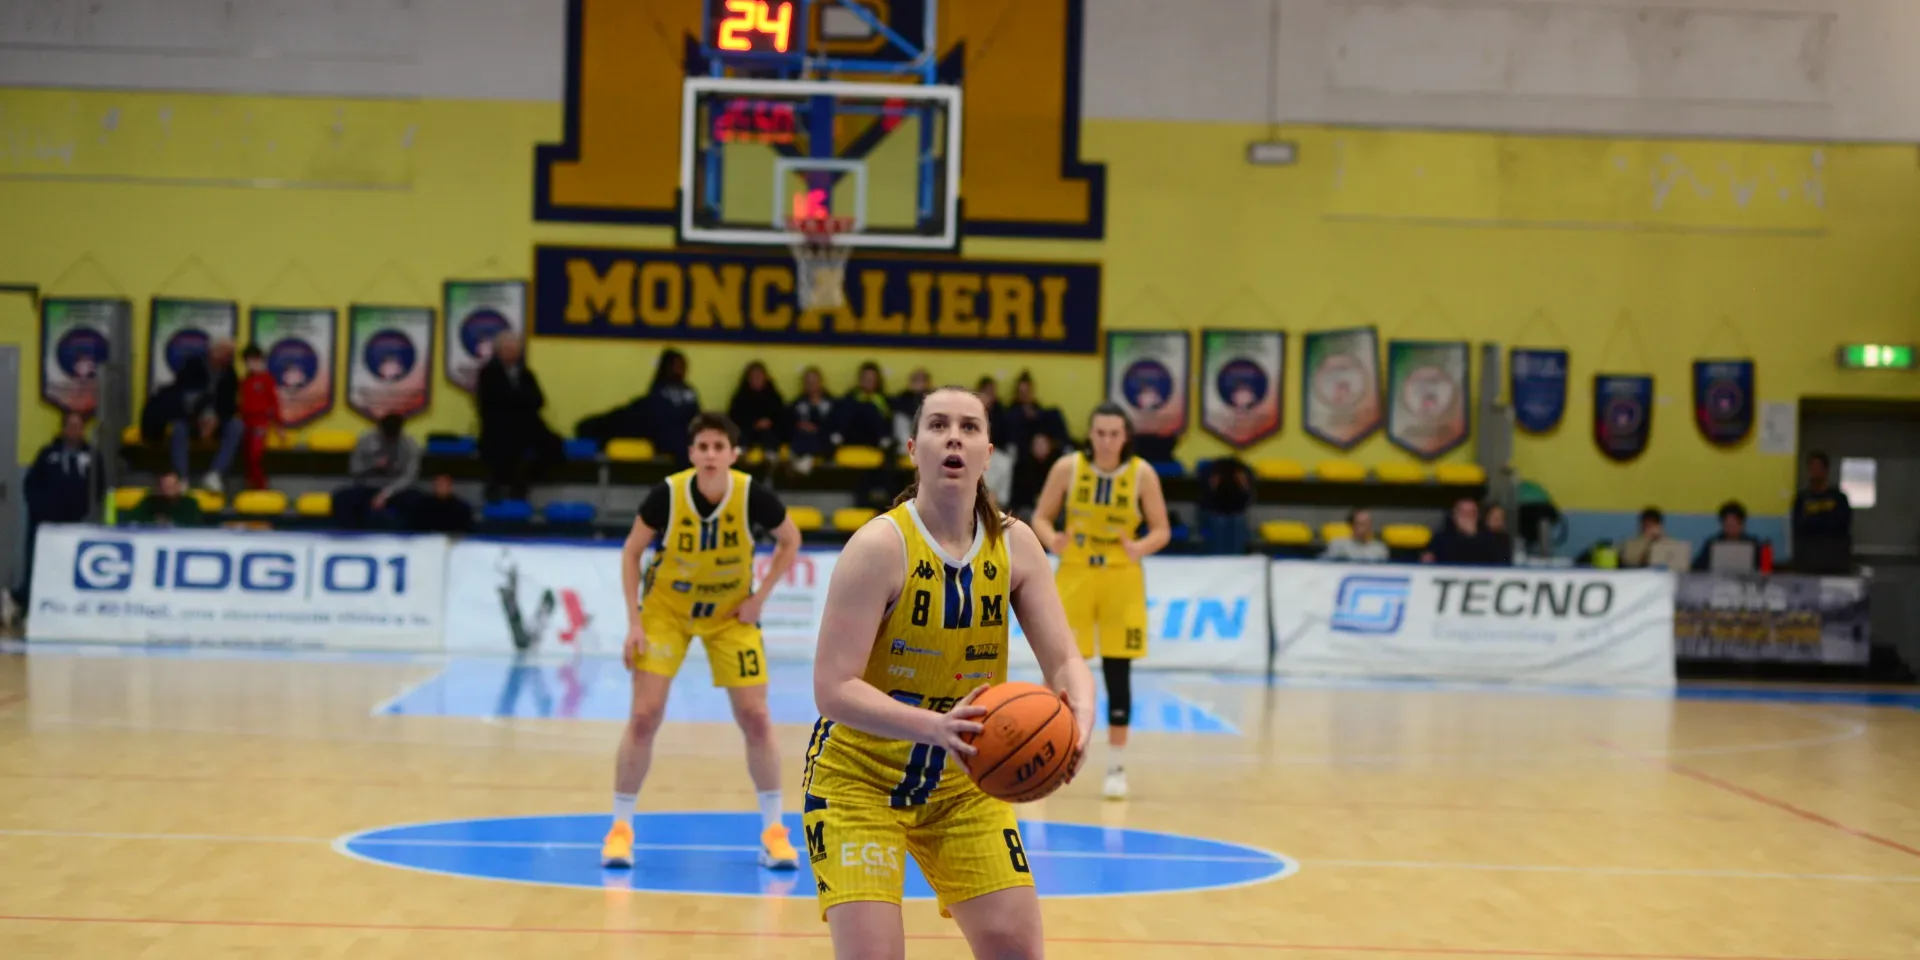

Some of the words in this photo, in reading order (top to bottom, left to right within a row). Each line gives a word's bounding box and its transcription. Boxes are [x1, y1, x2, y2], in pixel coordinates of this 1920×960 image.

[718, 0, 792, 53] 24
[565, 259, 1067, 338] MONCALIERI
[154, 548, 296, 592] IDG
[912, 590, 930, 626] 8
[980, 595, 1002, 621] M
[1432, 578, 1615, 618] TECNO
[737, 649, 760, 677] 13
[805, 821, 826, 857] M
[1003, 828, 1030, 873] 8
